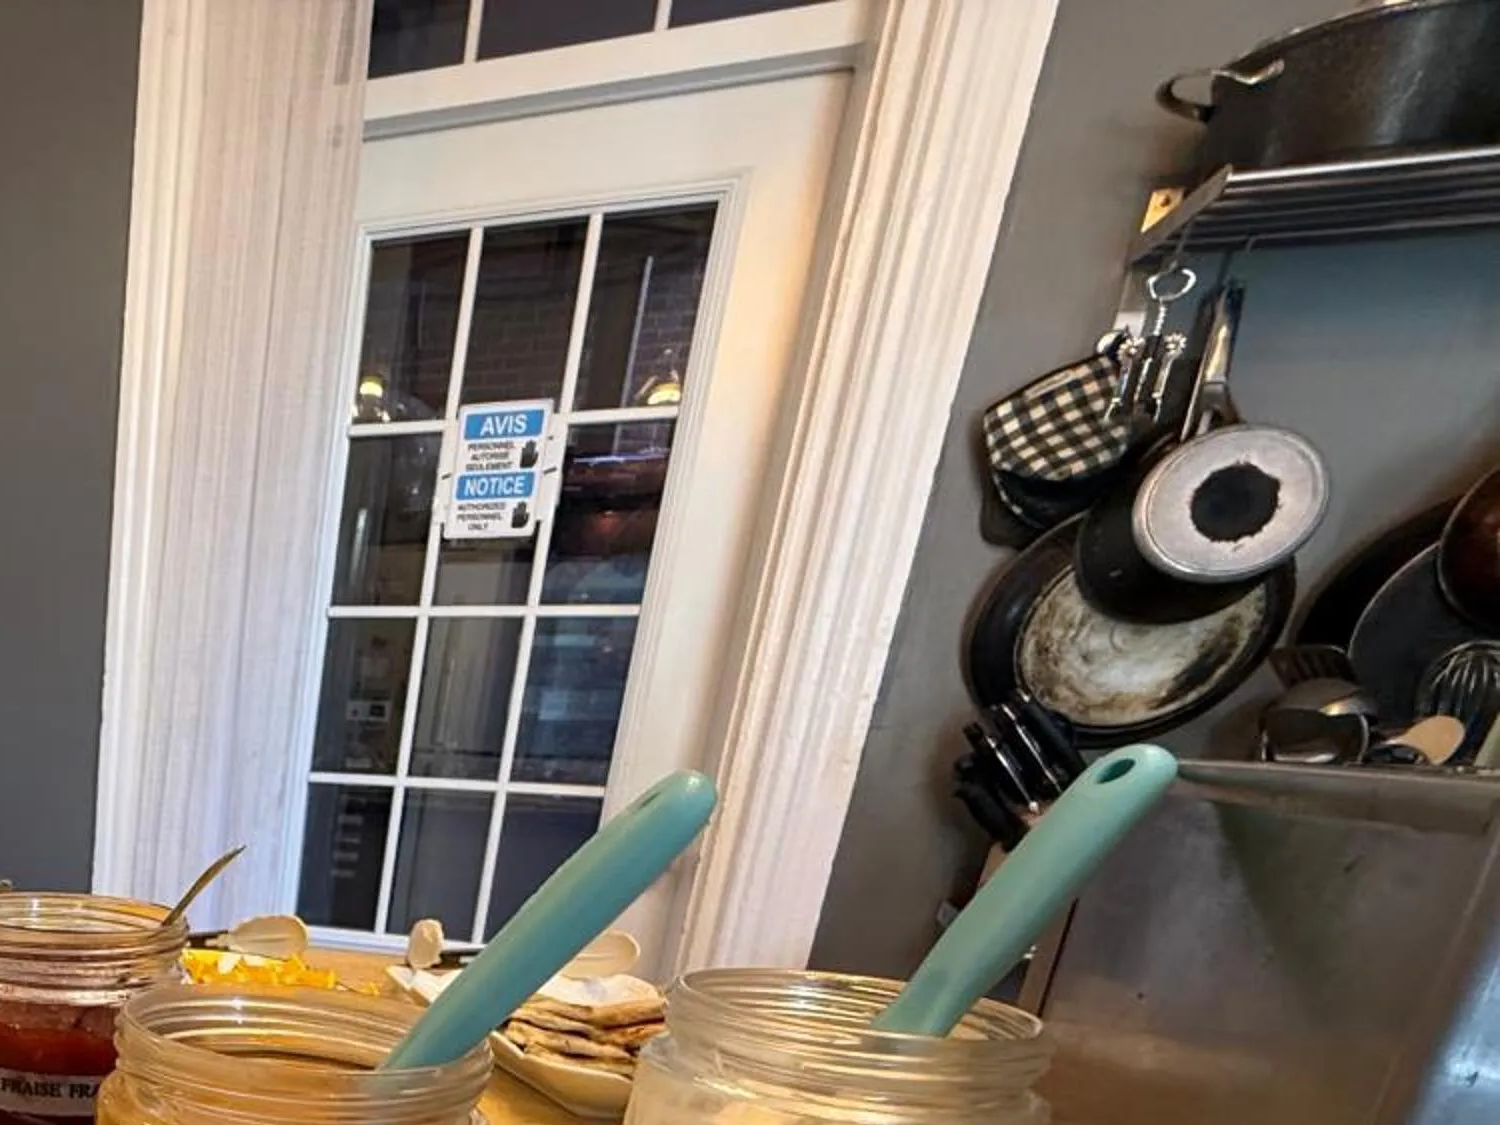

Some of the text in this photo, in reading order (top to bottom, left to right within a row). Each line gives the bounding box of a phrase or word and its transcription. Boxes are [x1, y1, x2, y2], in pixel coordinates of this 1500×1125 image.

[480, 414, 527, 436] AVIS
[464, 476, 525, 496] NOTICE
[2, 1077, 62, 1098] FRAISE
[69, 1084, 99, 1099] FRA
